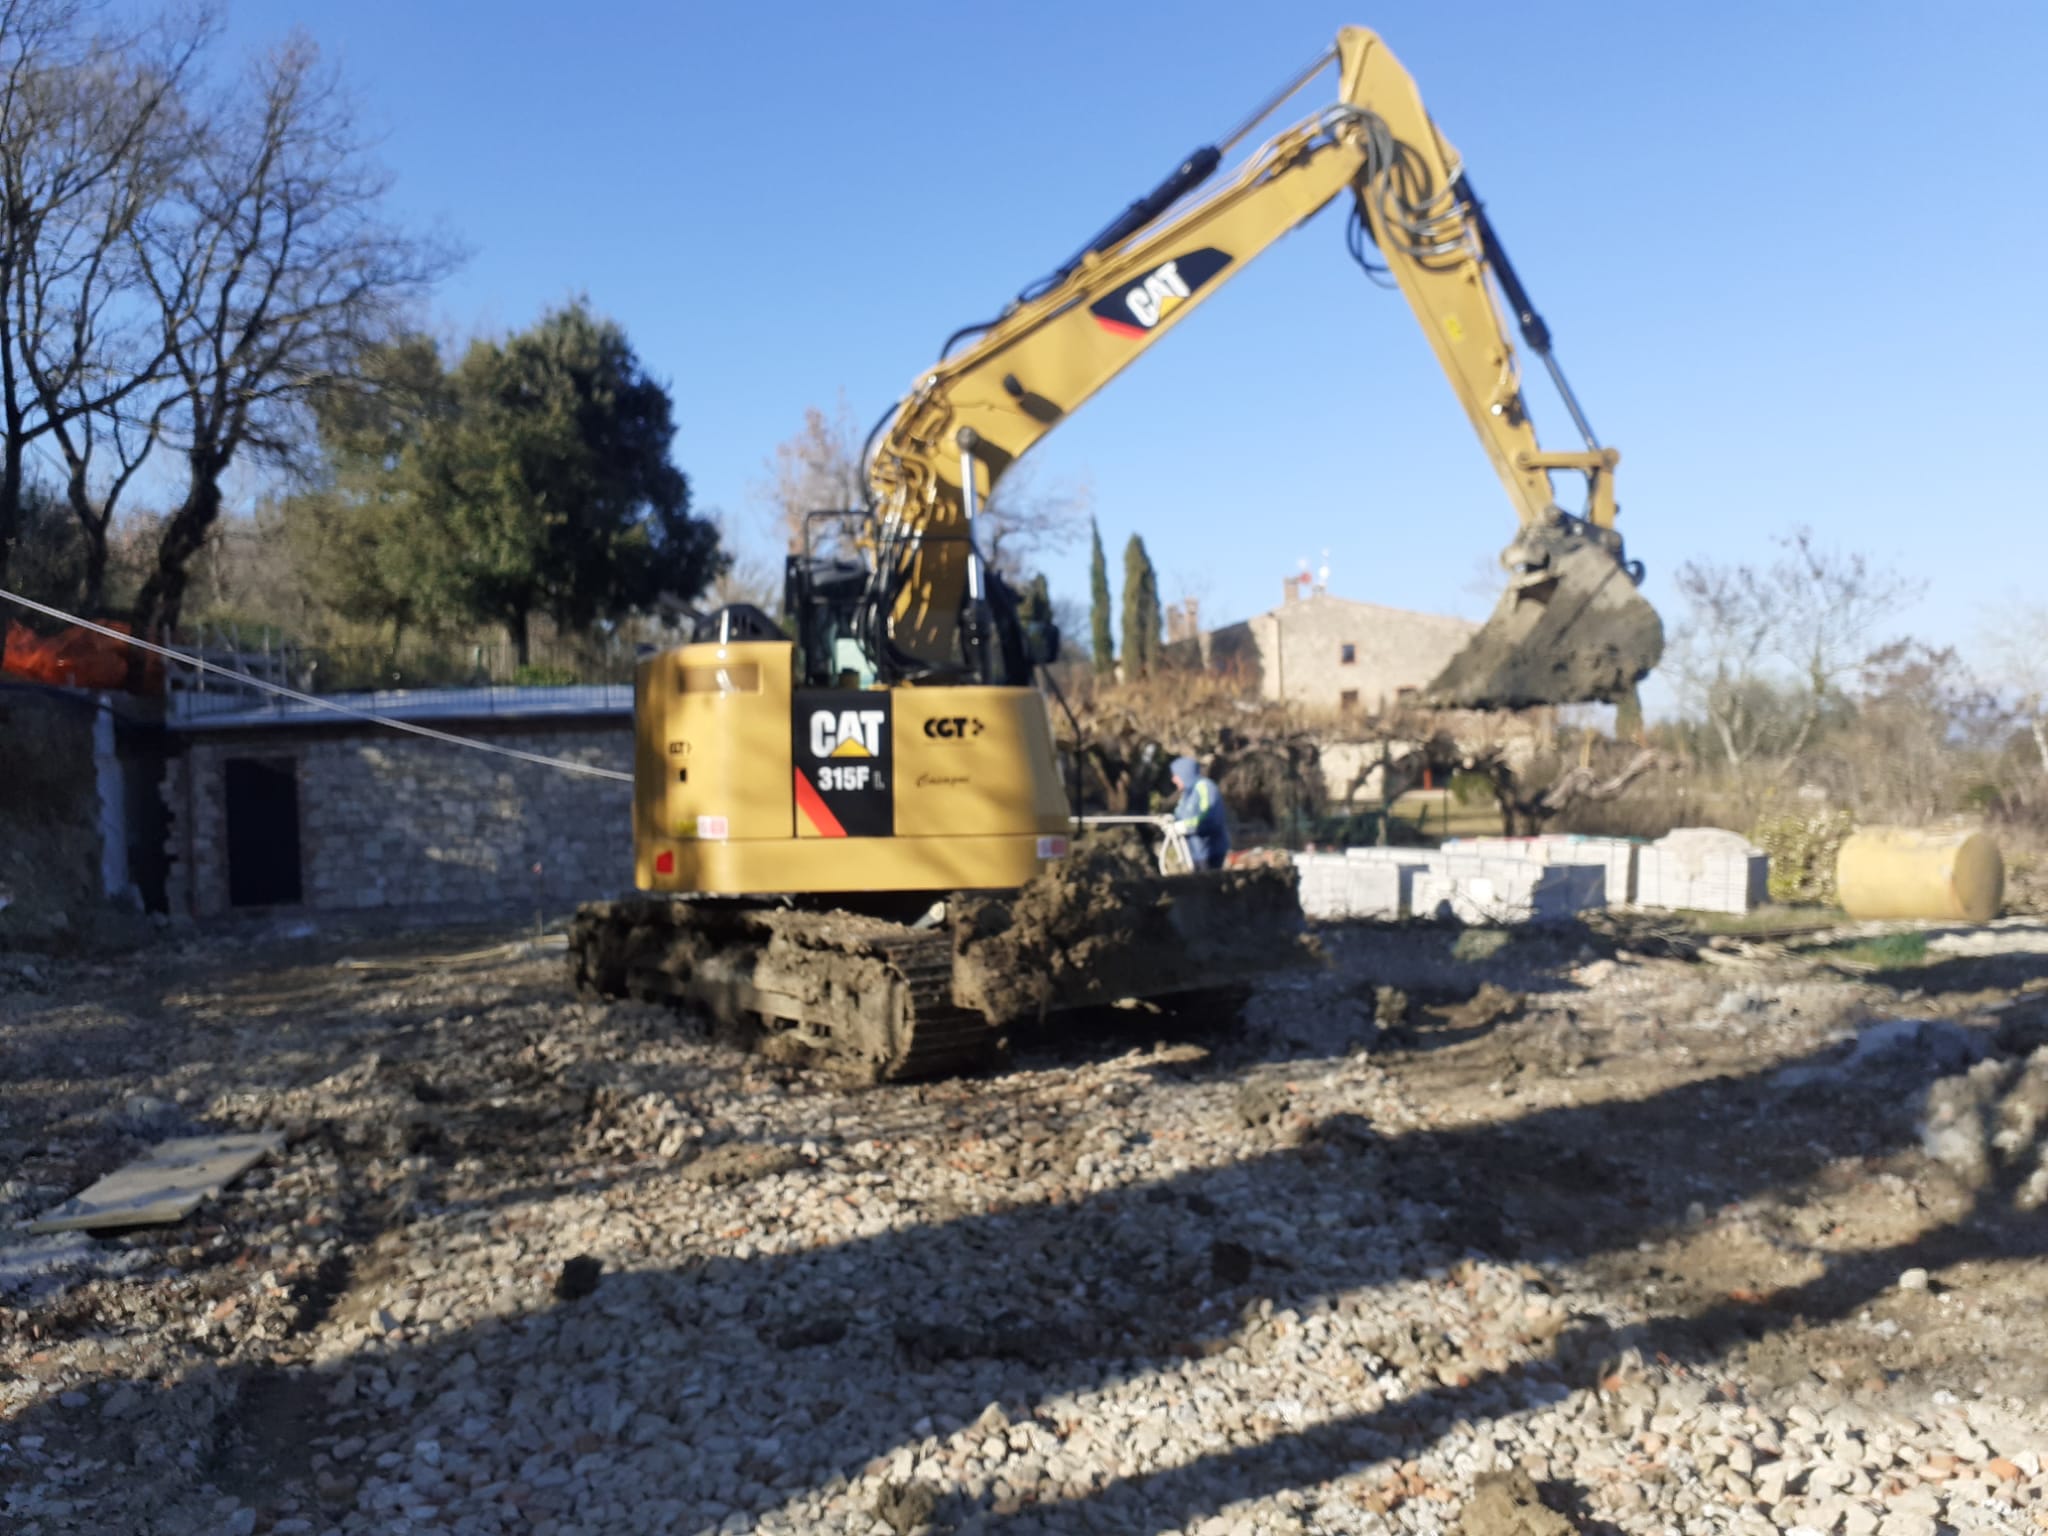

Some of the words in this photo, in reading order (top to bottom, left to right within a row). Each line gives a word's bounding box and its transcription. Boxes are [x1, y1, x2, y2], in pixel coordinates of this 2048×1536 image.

[1125, 260, 1190, 327] CAT
[810, 710, 884, 757] CAT
[923, 717, 967, 738] CGT
[818, 766, 869, 791] 315F
